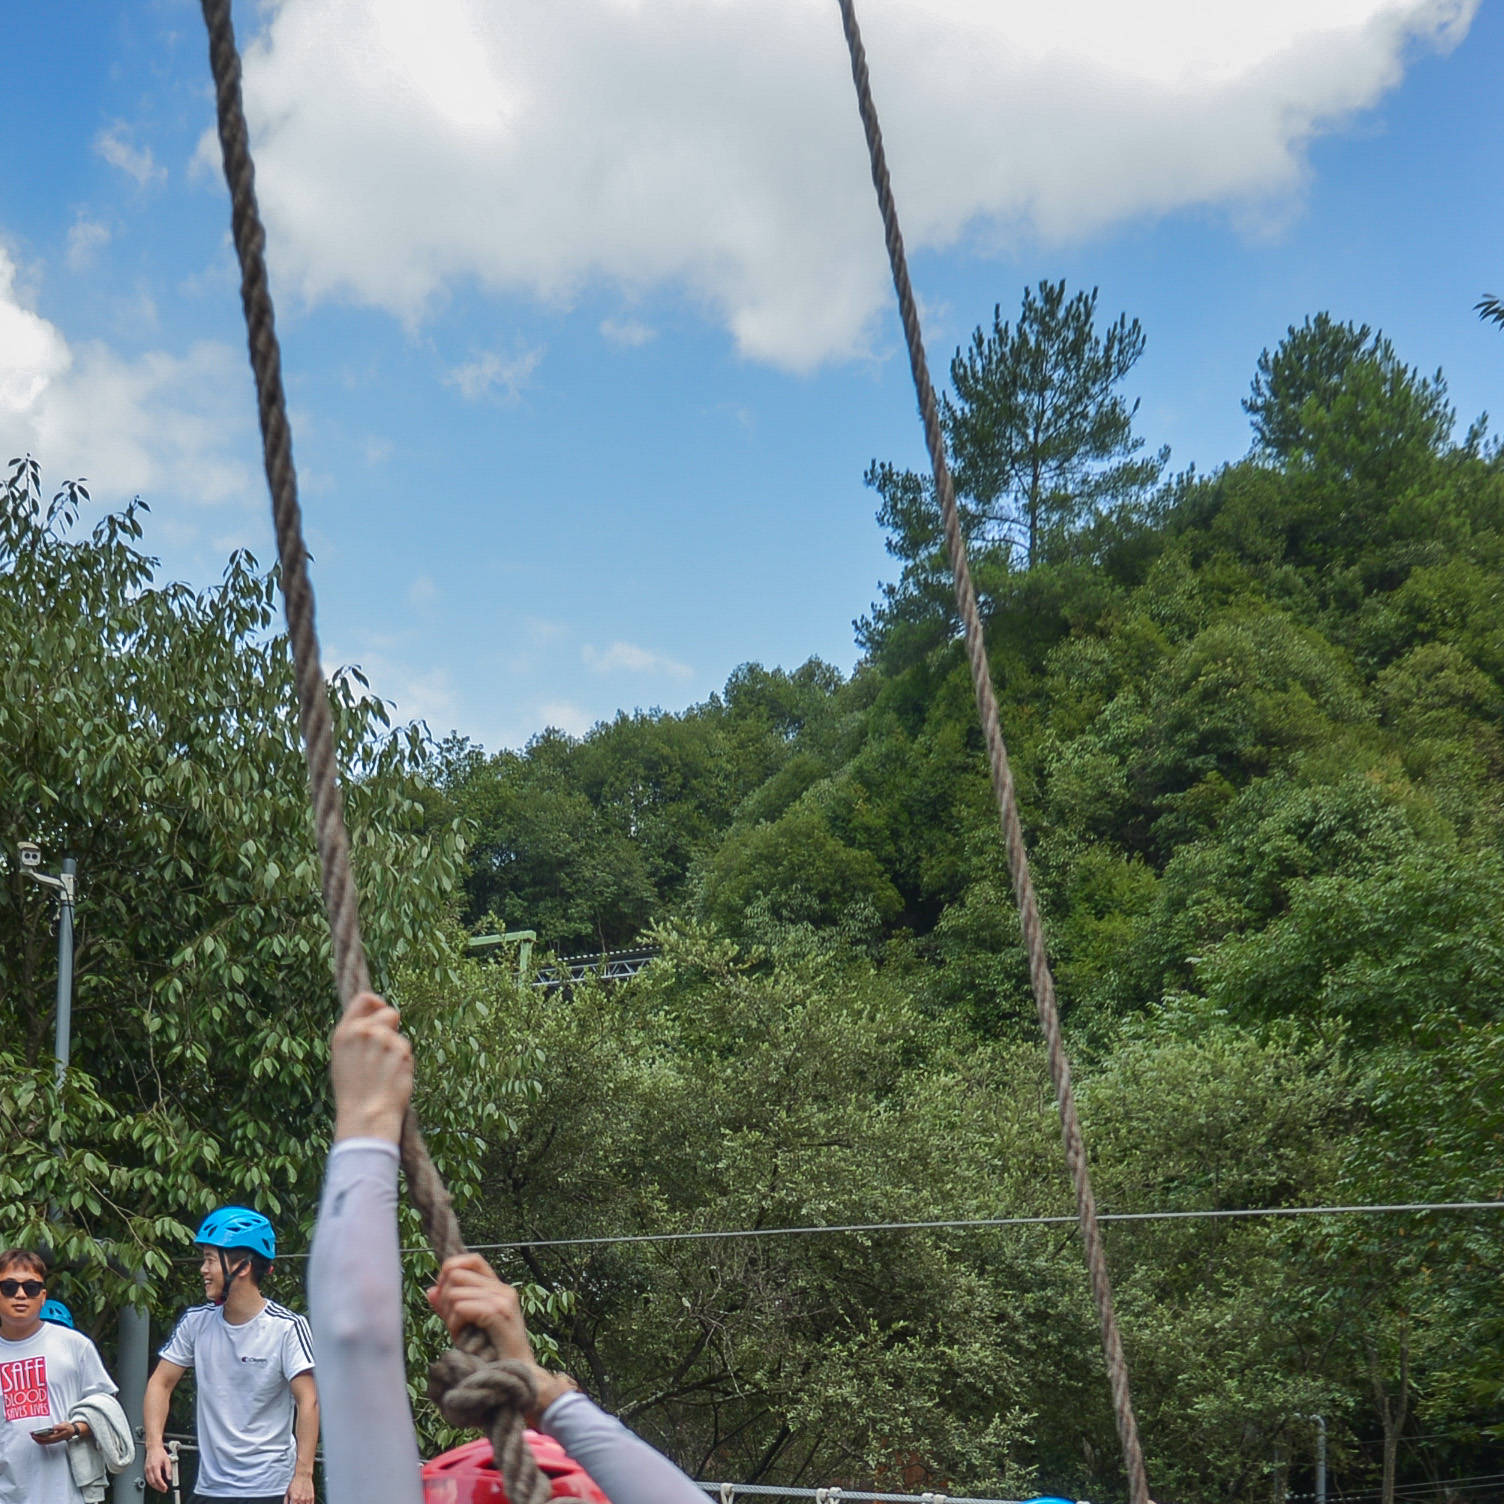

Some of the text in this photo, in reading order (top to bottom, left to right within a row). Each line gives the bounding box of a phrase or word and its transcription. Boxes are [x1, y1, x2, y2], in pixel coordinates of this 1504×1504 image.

[1, 1358, 46, 1393] SAFE
[4, 1388, 47, 1408] BLOOD
[6, 1403, 49, 1420] SAVES LIVES
